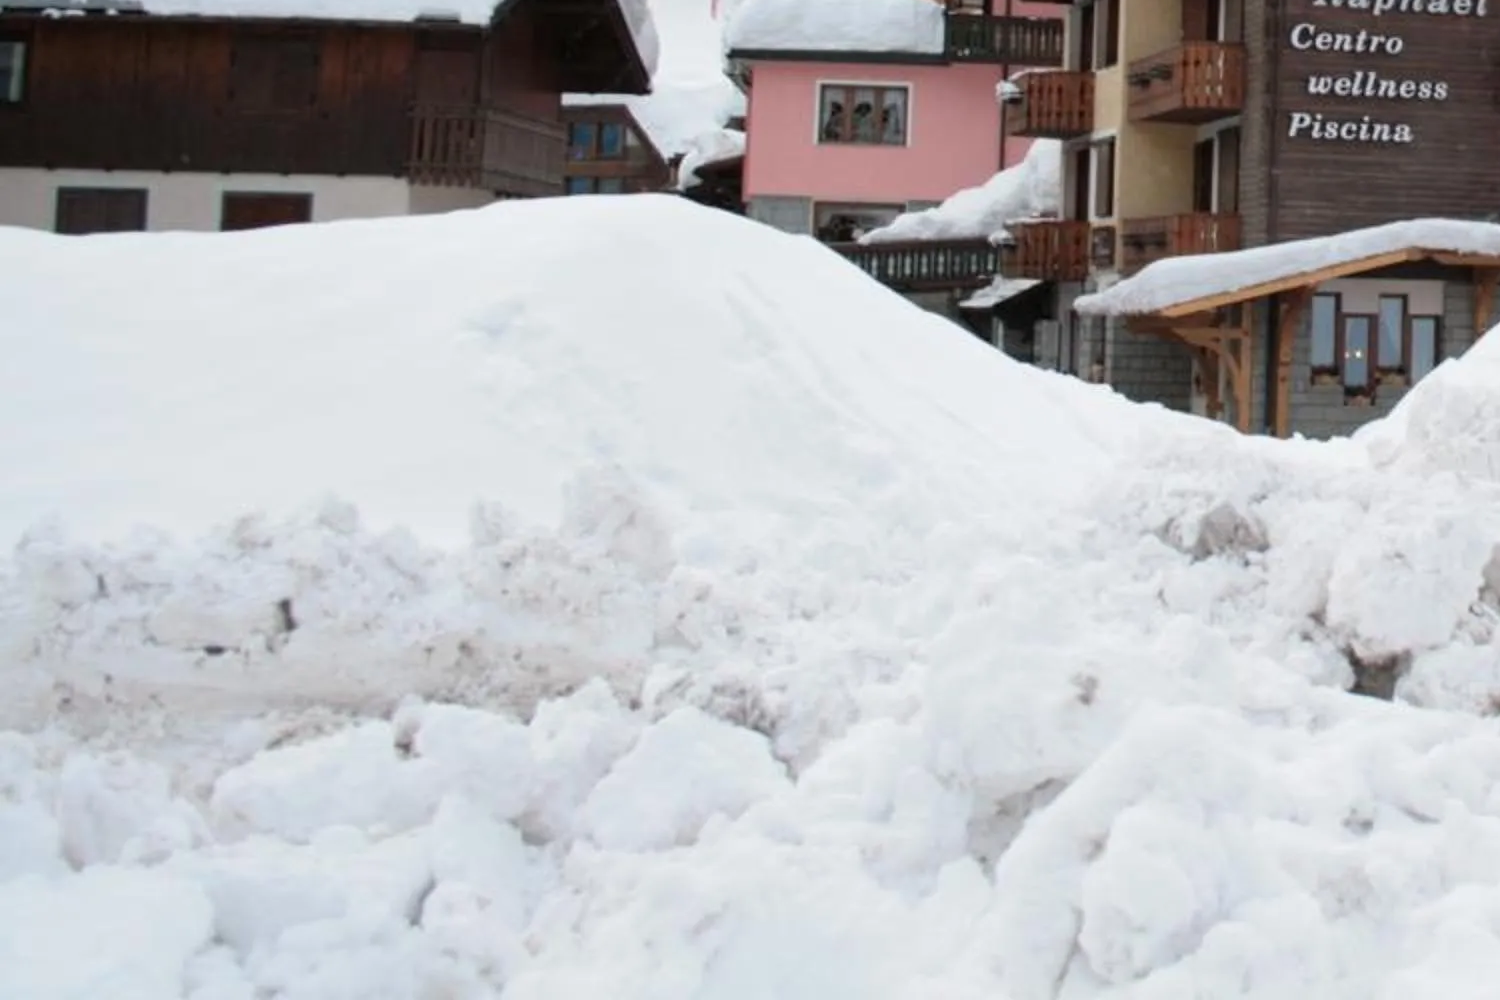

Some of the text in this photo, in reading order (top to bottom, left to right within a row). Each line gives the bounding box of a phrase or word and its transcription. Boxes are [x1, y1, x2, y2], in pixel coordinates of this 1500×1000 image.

[1290, 23, 1403, 54] Centro
[1307, 72, 1449, 100] wellness
[1288, 112, 1414, 142] Piscina
